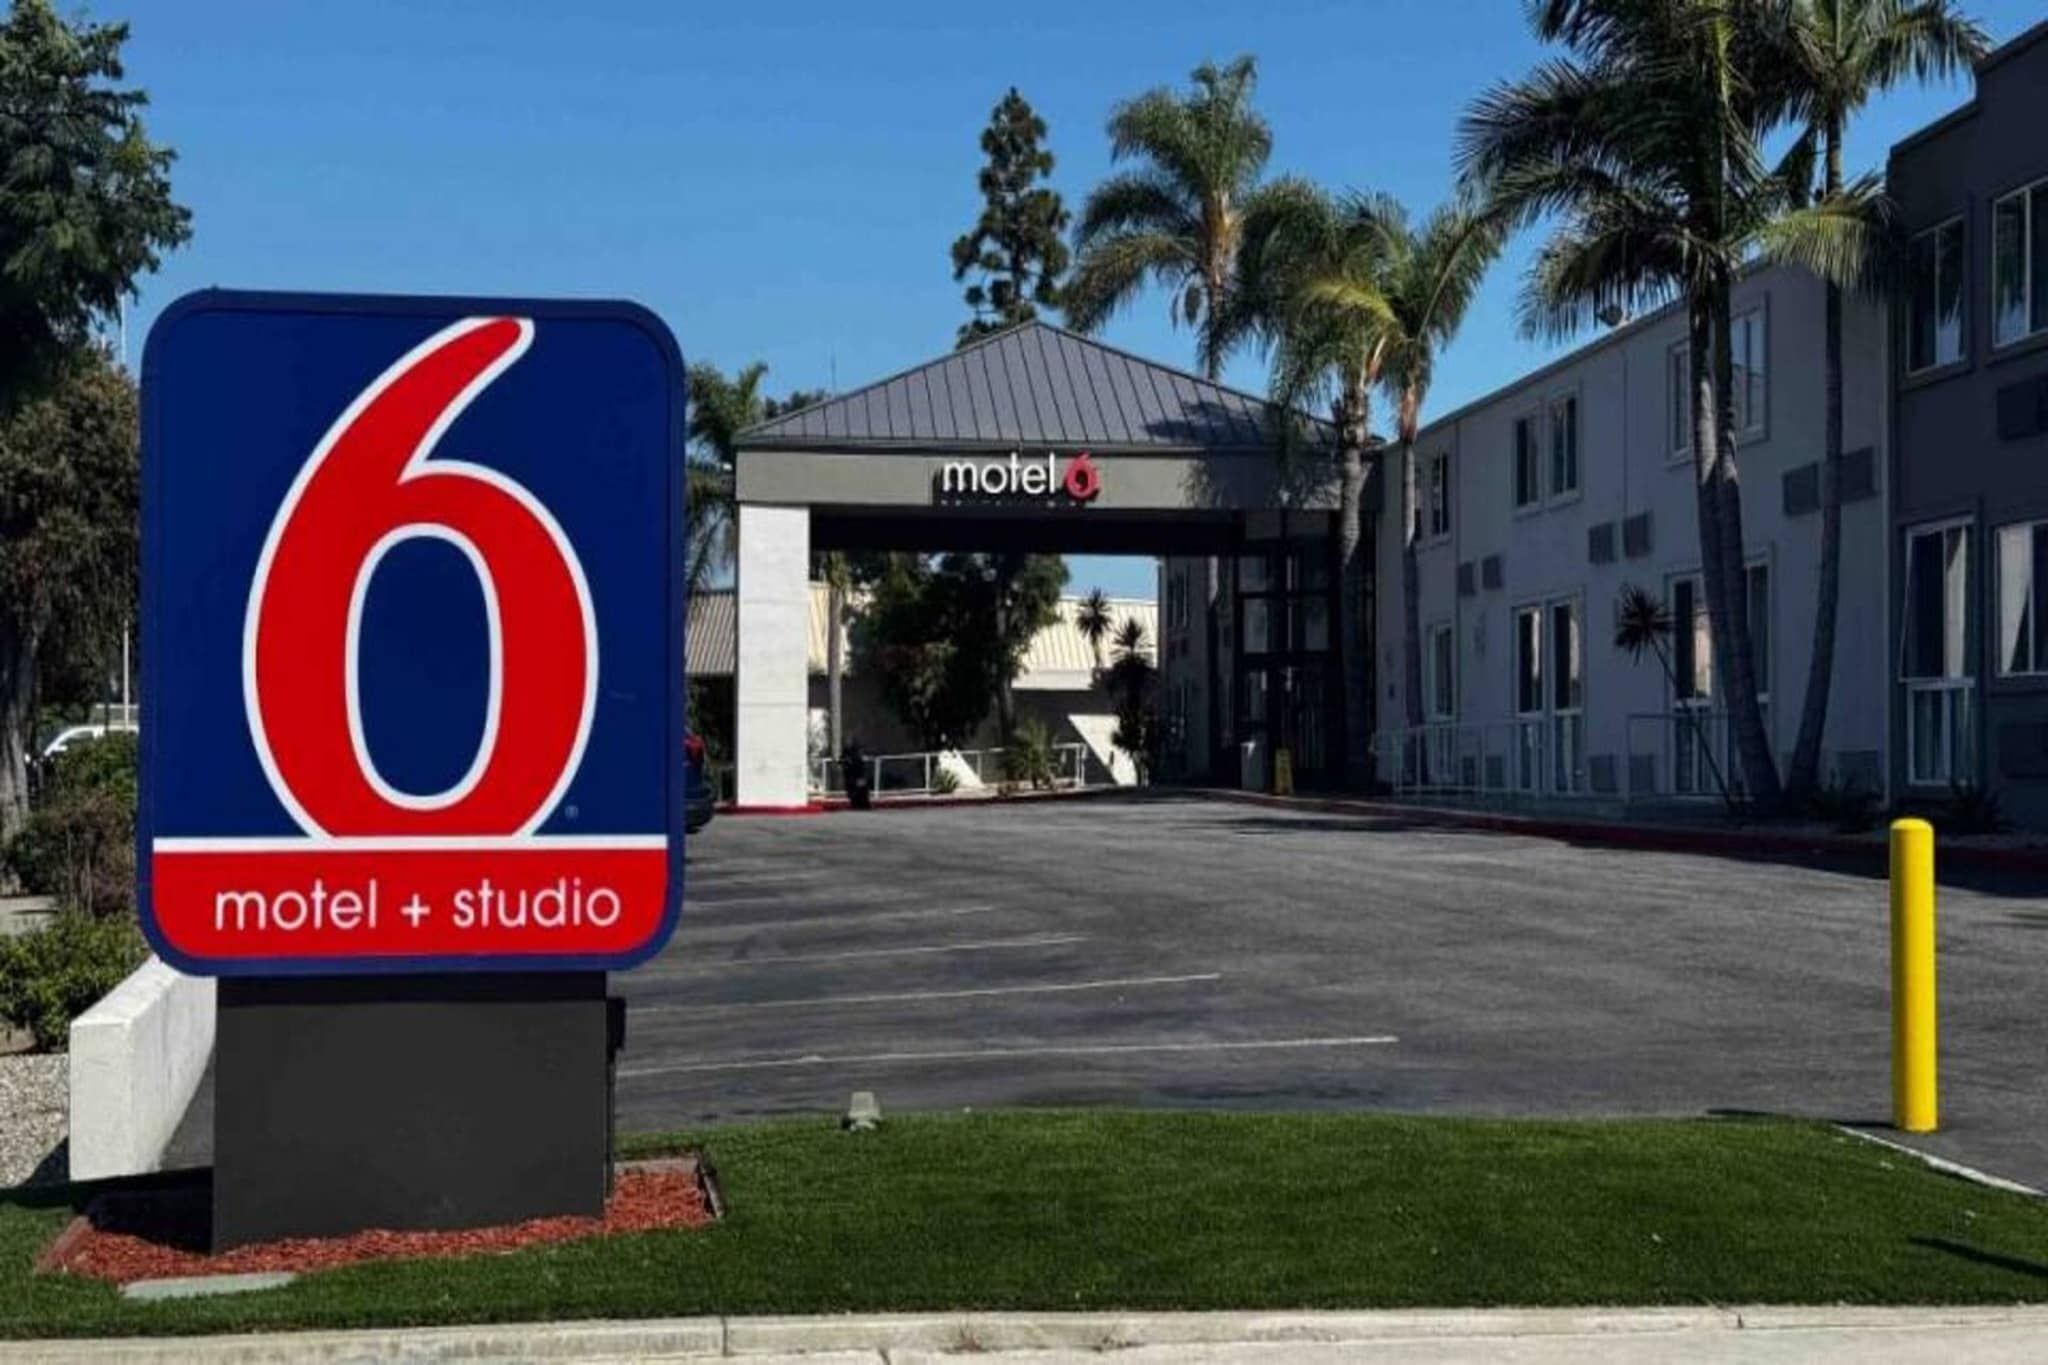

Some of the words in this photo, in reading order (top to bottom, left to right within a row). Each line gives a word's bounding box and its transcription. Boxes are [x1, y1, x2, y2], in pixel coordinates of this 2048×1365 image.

[943, 452, 1057, 495] motel
[1065, 450, 1100, 498] 6
[243, 316, 600, 838] 6
[214, 879, 378, 931] motel
[453, 877, 621, 930] studio
